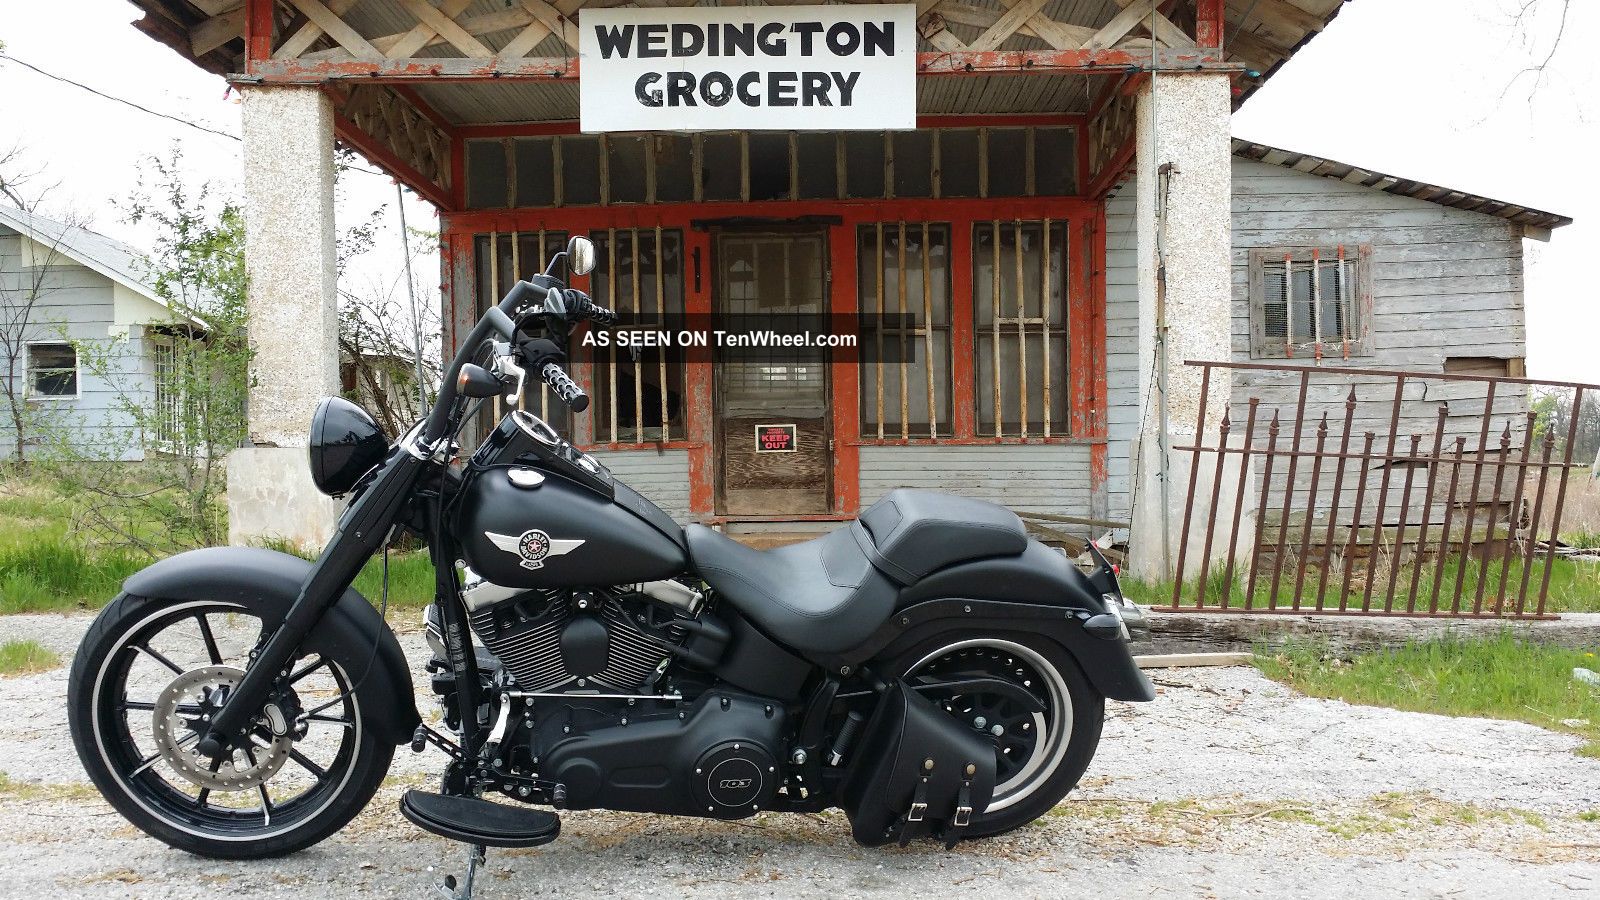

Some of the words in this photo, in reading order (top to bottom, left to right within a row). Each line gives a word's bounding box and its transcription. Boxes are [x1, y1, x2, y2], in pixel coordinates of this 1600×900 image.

[594, 21, 895, 59] WEDINGTON
[635, 71, 861, 108] GROCERY
[523, 533, 548, 543] HARLEY
[520, 545, 548, 560] DAVIDSON
[719, 778, 752, 789] 103
